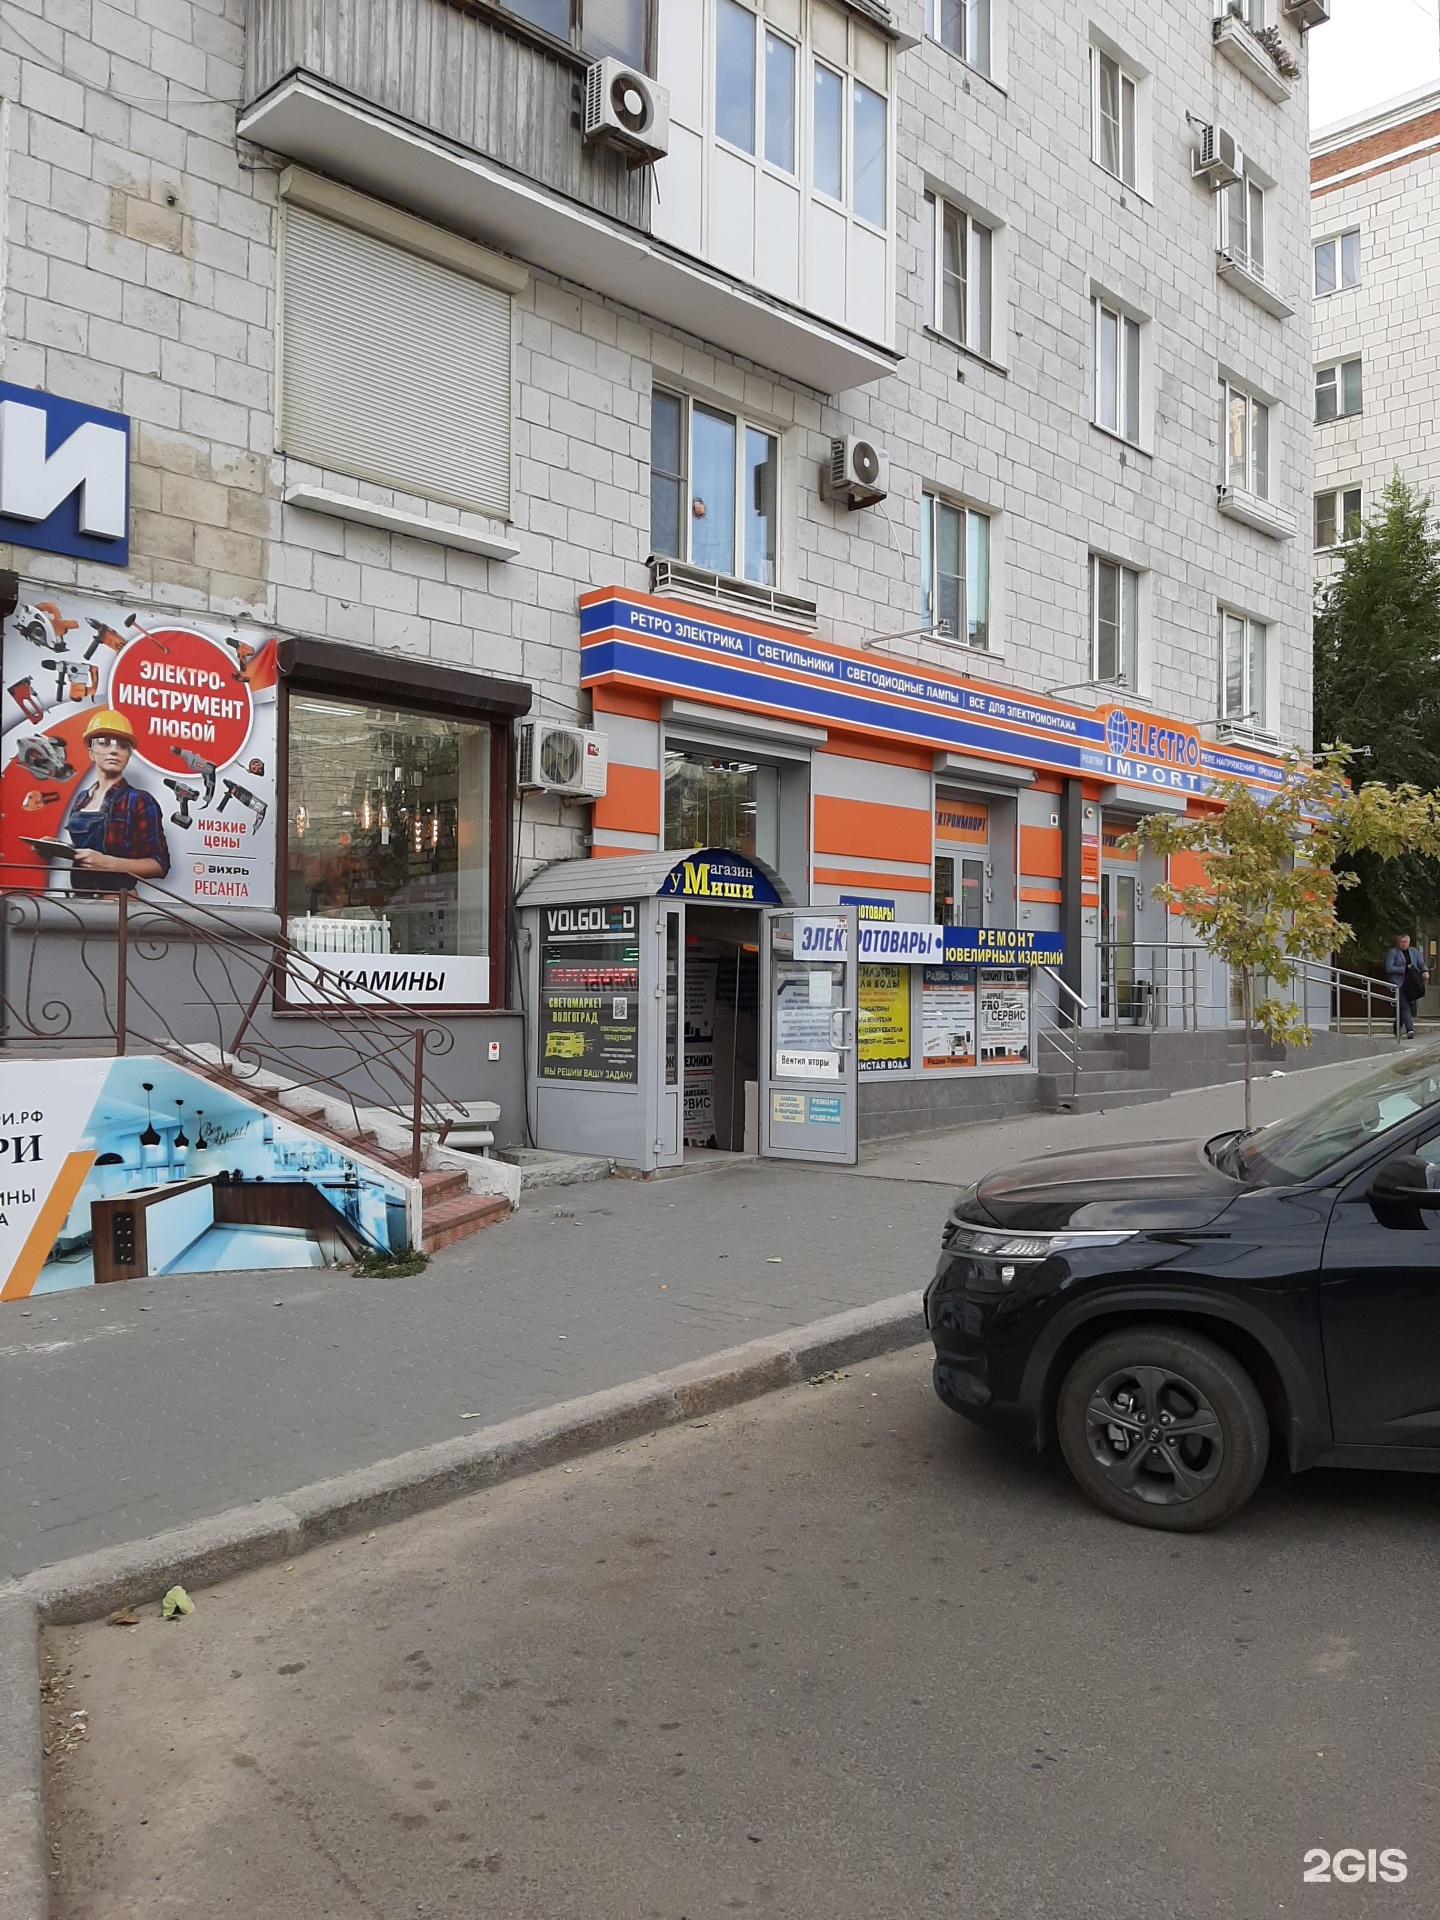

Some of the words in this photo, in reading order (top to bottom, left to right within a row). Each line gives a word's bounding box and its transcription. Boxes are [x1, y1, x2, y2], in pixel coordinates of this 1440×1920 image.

[630, 611, 672, 633] РЕТРО
[675, 623, 744, 652] ЭЛЕКТРИКА
[757, 644, 835, 674] СВЕТИЛЬНИКИ
[846, 666, 925, 696] СВЕТОДИОДНЫЕ
[926, 687, 959, 704] ЛАМПЫ
[119, 684, 243, 720] ИНСТРУМЕНТ
[969, 696, 986, 710] ВСЕ
[988, 701, 1006, 715] ДЛЯ
[1006, 705, 1077, 732] ЭЛЕКТРОМОНТАЖА
[148, 717, 216, 744] ЛЮБОЙ
[1129, 719, 1199, 767] ELECTRO
[1107, 756, 1198, 790] IMPORT
[1216, 756, 1256, 773] НАПРЯЖЕНИЯ
[1258, 767, 1283, 780] ПРОВОДА
[203, 834, 241, 849] цены
[194, 881, 249, 898] РЕСАНТА
[670, 872, 682, 893] у
[978, 930, 1035, 948] РЕМОНТ
[945, 947, 1015, 964] ЮВЕЛИРНЫХ
[1018, 949, 1064, 966] ИЗДЕЛИЙ
[338, 969, 446, 992] КАМИНЫ
[859, 967, 900, 978] ИЛЬТРЫ
[859, 979, 871, 988] ЛЯ
[874, 979, 900, 989] ВОДЫ
[548, 997, 602, 1009] СВЕТОМАРКЕТ
[992, 1010, 1026, 1021] СЕРВИС
[684, 1054, 713, 1068] ЕХНИКИ
[859, 1061, 886, 1070] ИСТАЯ
[583, 1069, 604, 1078] ВАШУ
[605, 1070, 633, 1081] ЗАДАЧУ
[812, 1098, 839, 1106] РЕМОНТ
[0, 1111, 43, 1126] И.РФ
[1147, 1426, 1160, 1441] KIA
